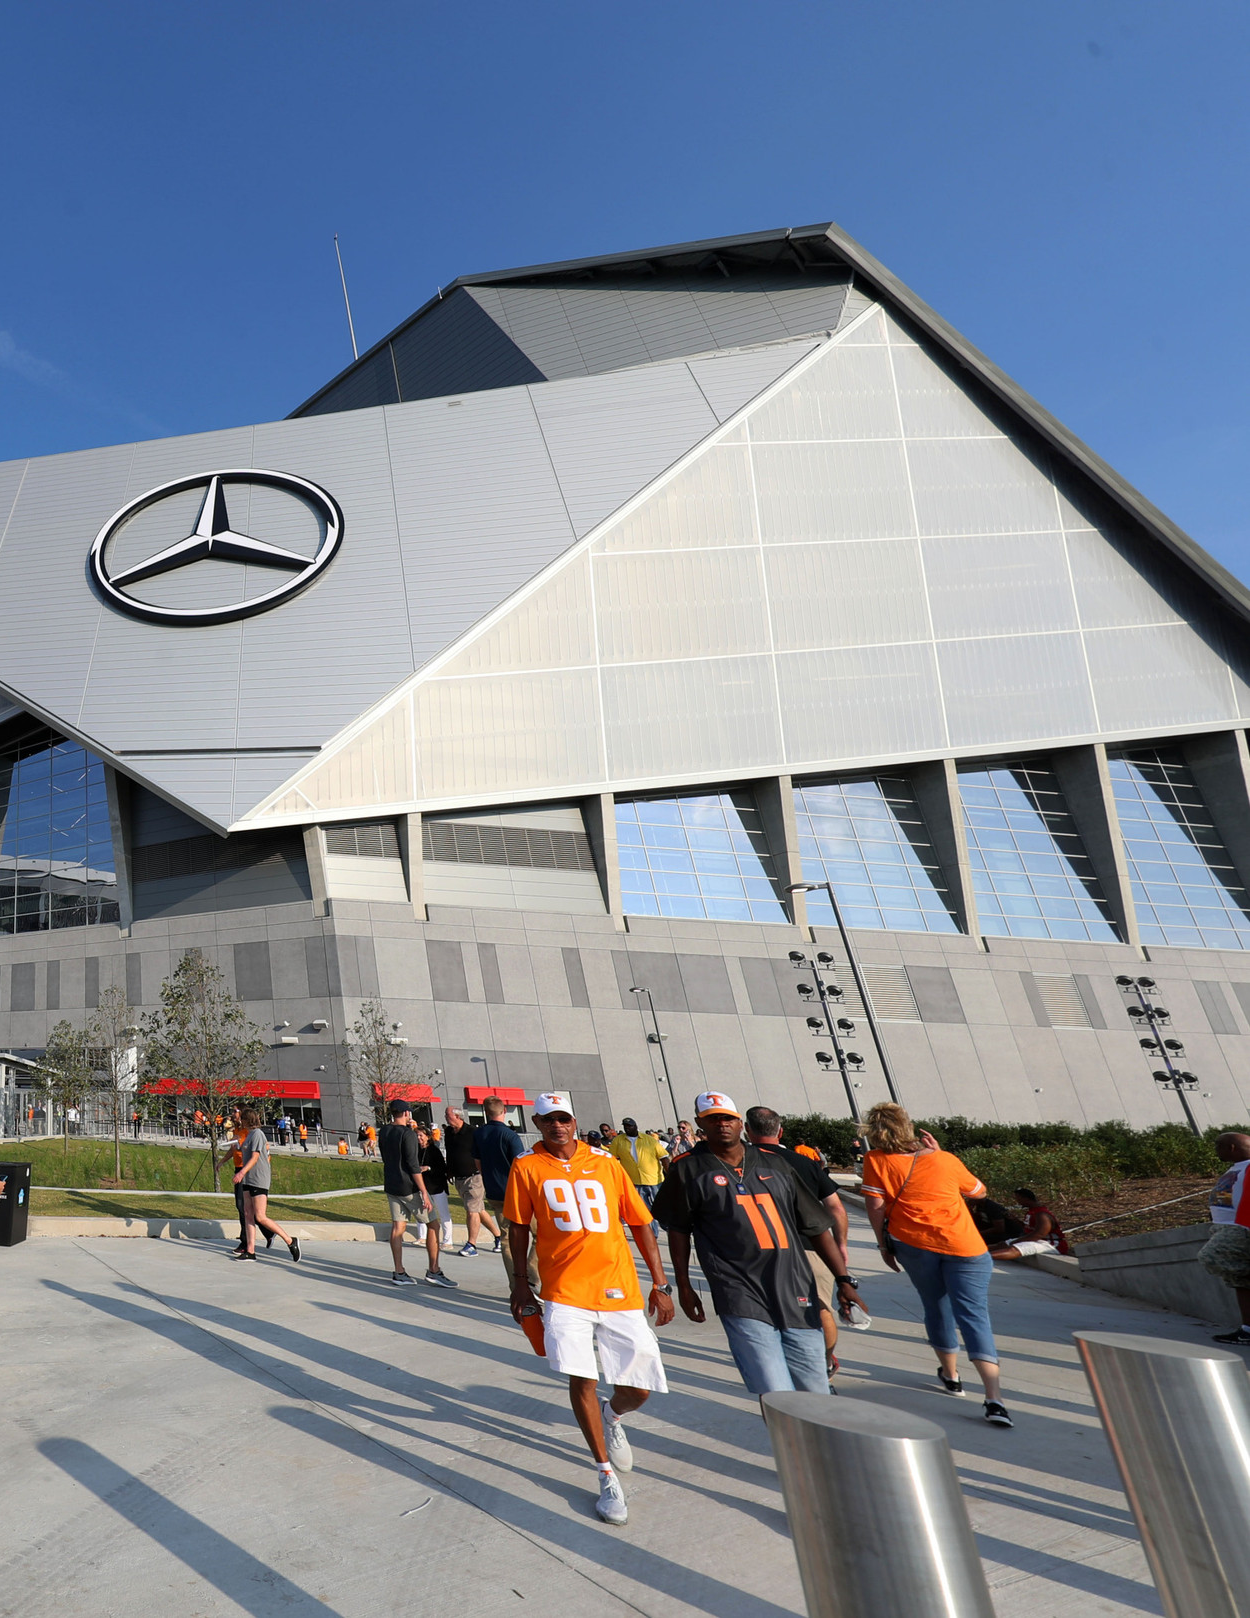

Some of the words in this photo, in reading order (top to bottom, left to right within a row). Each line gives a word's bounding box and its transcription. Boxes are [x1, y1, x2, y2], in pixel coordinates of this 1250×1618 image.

[547, 1095, 562, 1105] T
[707, 1094, 724, 1107] T
[562, 1164, 572, 1172] T
[733, 1167, 744, 1177] T
[543, 1179, 609, 1233] 98
[735, 1193, 790, 1249] 11
